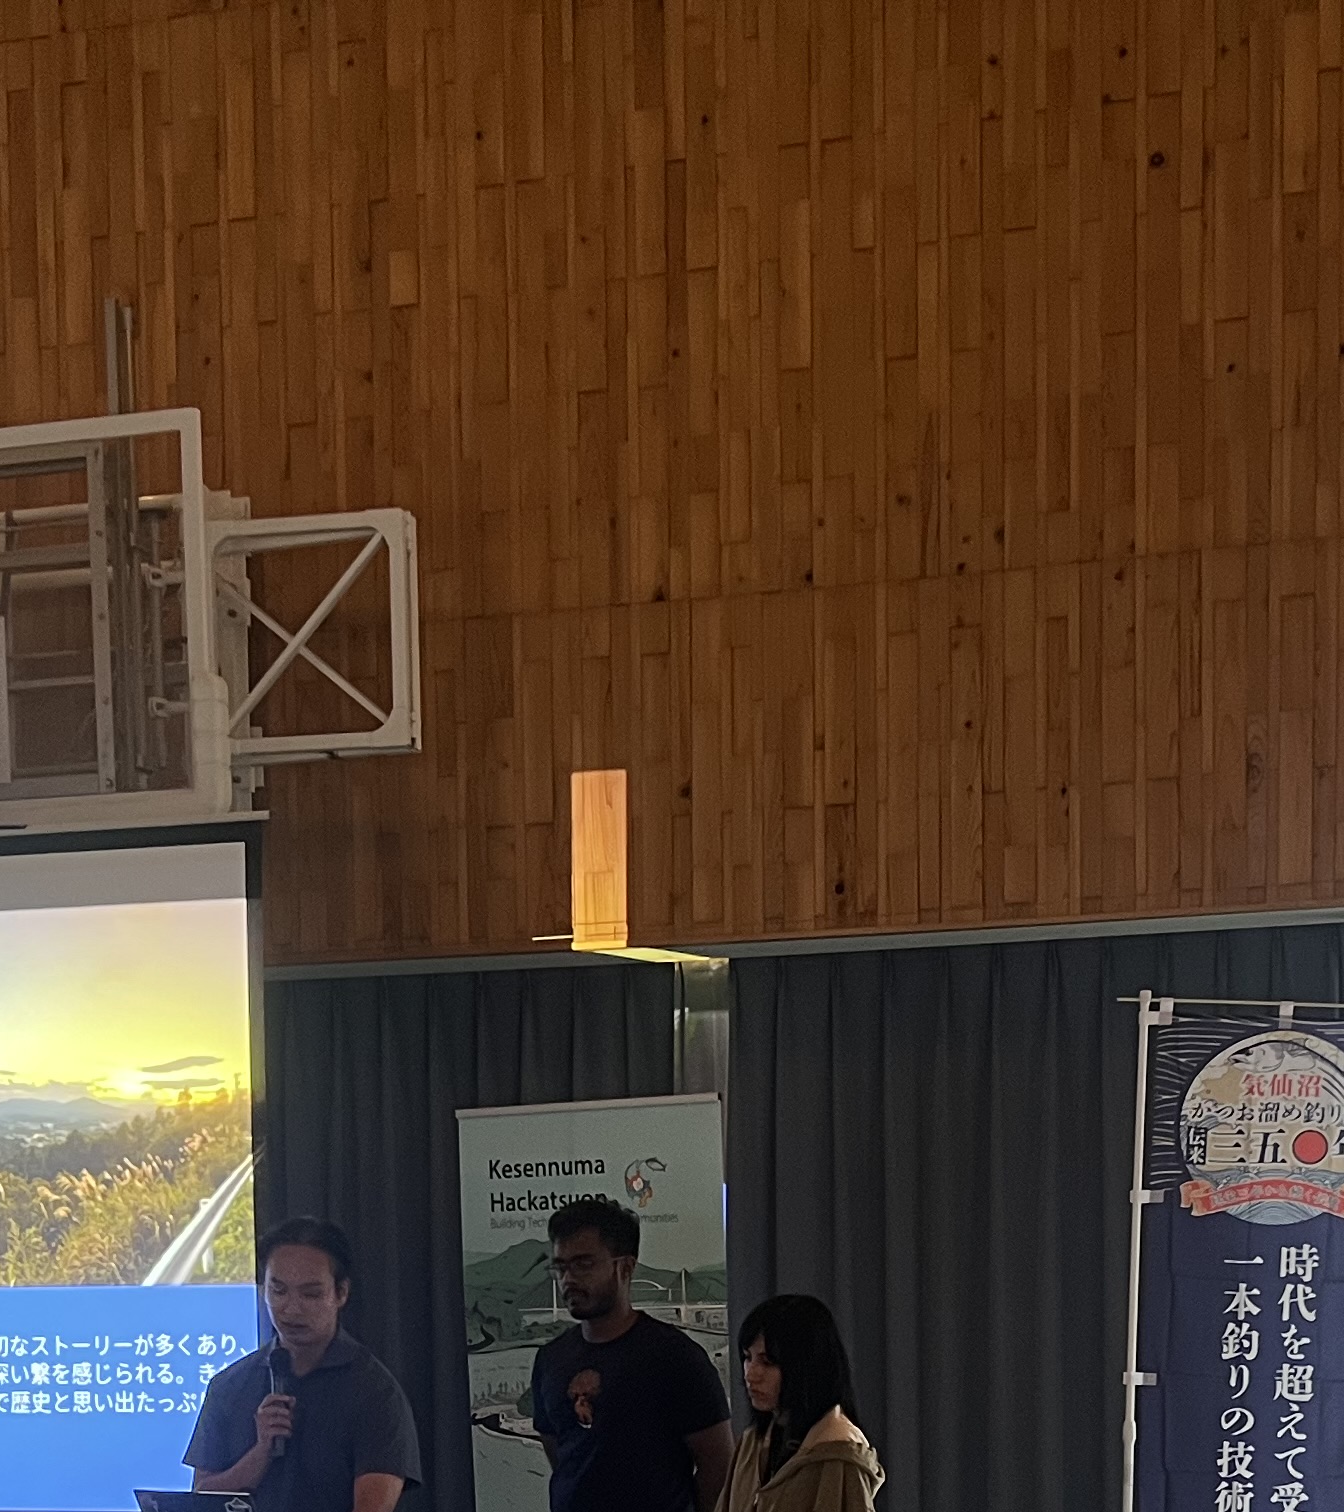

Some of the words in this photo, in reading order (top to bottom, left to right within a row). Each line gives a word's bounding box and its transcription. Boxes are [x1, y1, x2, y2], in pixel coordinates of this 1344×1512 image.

[1241, 1073, 1323, 1098] 気仙沼
[1189, 1127, 1205, 1164] 伝来
[489, 1159, 605, 1179] Kesennuma
